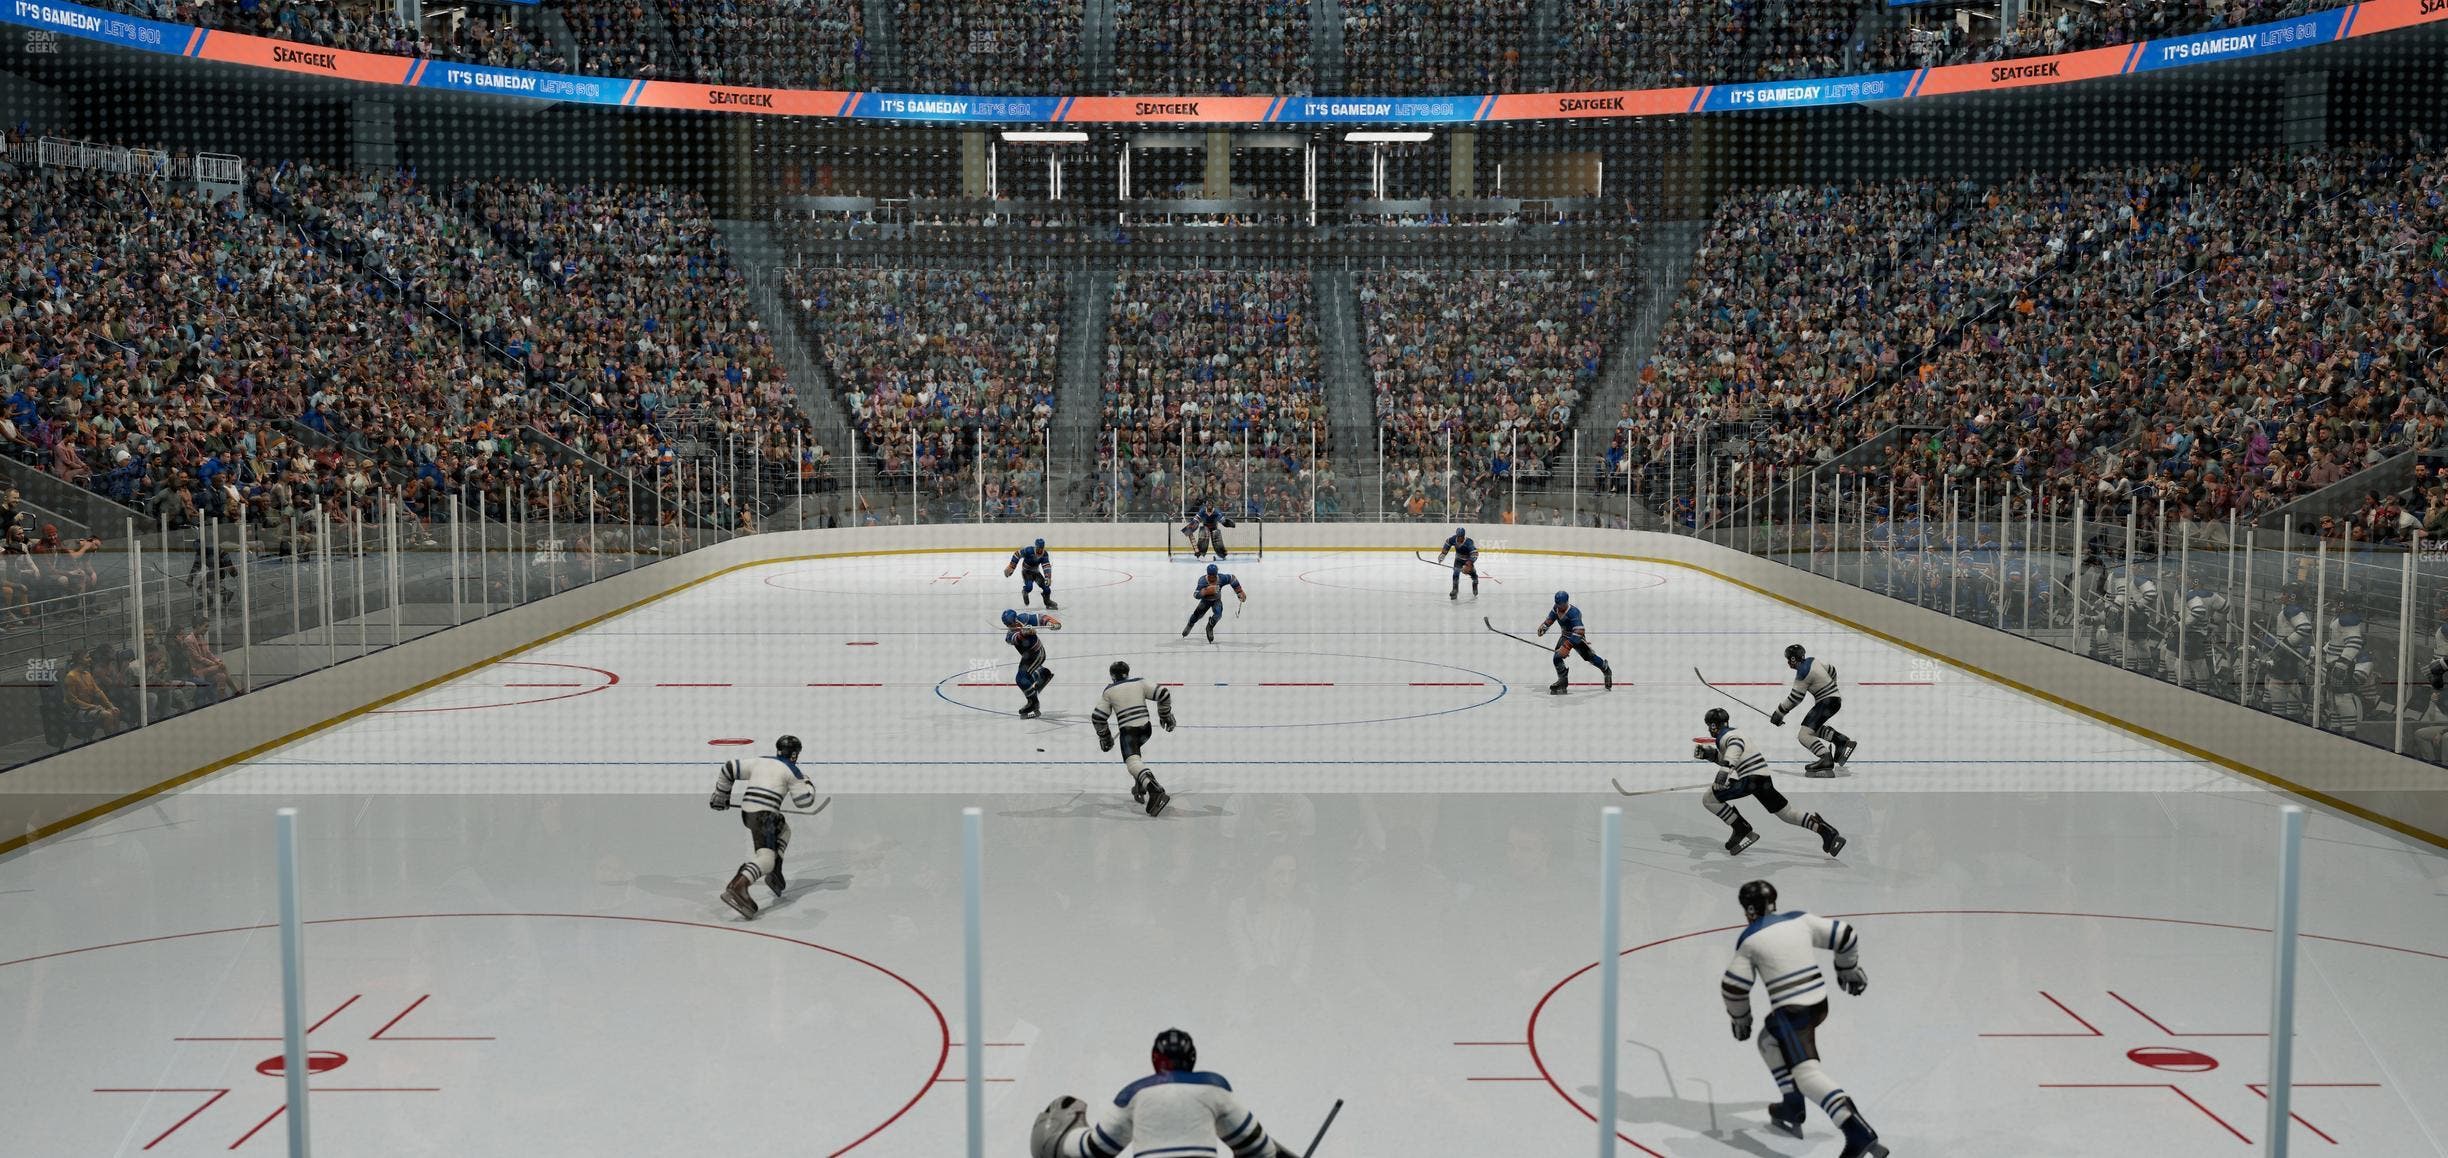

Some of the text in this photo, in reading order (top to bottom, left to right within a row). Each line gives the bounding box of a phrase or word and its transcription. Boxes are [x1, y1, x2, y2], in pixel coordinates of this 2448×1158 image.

[2420, 0, 2448, 15] SEA
[15, 0, 161, 44] IT'S GAMEDAY LET'S GO!
[2164, 22, 2318, 60] IT'S GAMEDAY LET'S GO!
[273, 46, 337, 70] SEATGEEK
[1991, 61, 2060, 82] SEATGEEK
[447, 70, 472, 84] IT'S
[475, 73, 537, 90] GAMEDAY
[539, 79, 575, 94] LET'S
[1730, 80, 1884, 103] IT'S GAMEDAY LET'S GO!
[709, 91, 773, 108] SEATGEEK
[881, 100, 1031, 116] IT'S GAMEDAY LET'S GO!
[1135, 102, 1199, 116] SEATGEEK
[1559, 97, 1624, 112] SEATGEEK
[1305, 103, 1328, 116] IT'S
[1331, 103, 1391, 116] GAMEDAY
[1394, 103, 1430, 116] LET'S
